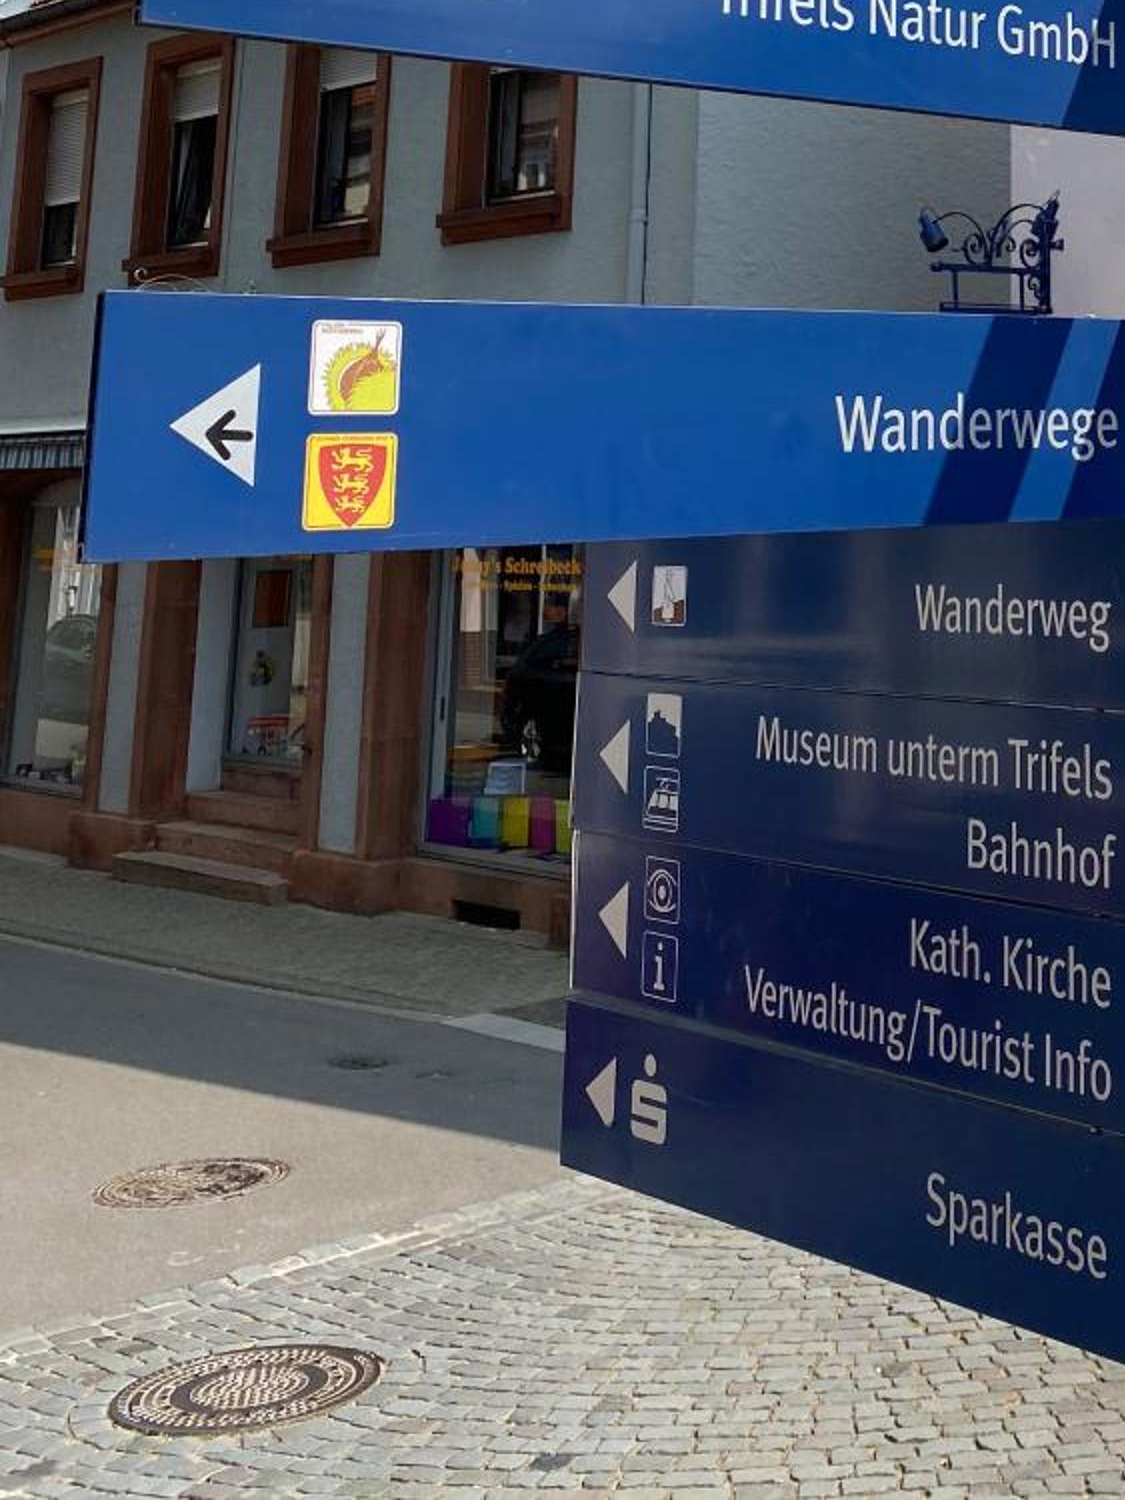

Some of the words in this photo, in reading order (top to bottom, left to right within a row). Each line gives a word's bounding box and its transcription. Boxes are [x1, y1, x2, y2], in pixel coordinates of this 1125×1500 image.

[997, 5, 1116, 69] GmbH
[835, 392, 1119, 462] Wanderwege
[915, 583, 1112, 653] Wanderweg
[756, 715, 877, 773] Museum
[887, 737, 999, 788] unterm
[1008, 739, 1113, 800] Trifels
[967, 818, 1116, 889] Bahnhof
[910, 918, 991, 985] Kath.
[1002, 935, 1112, 1009] Kirche
[1045, 1033, 1112, 1102] Info
[926, 1172, 1108, 1279] Sparkasse
